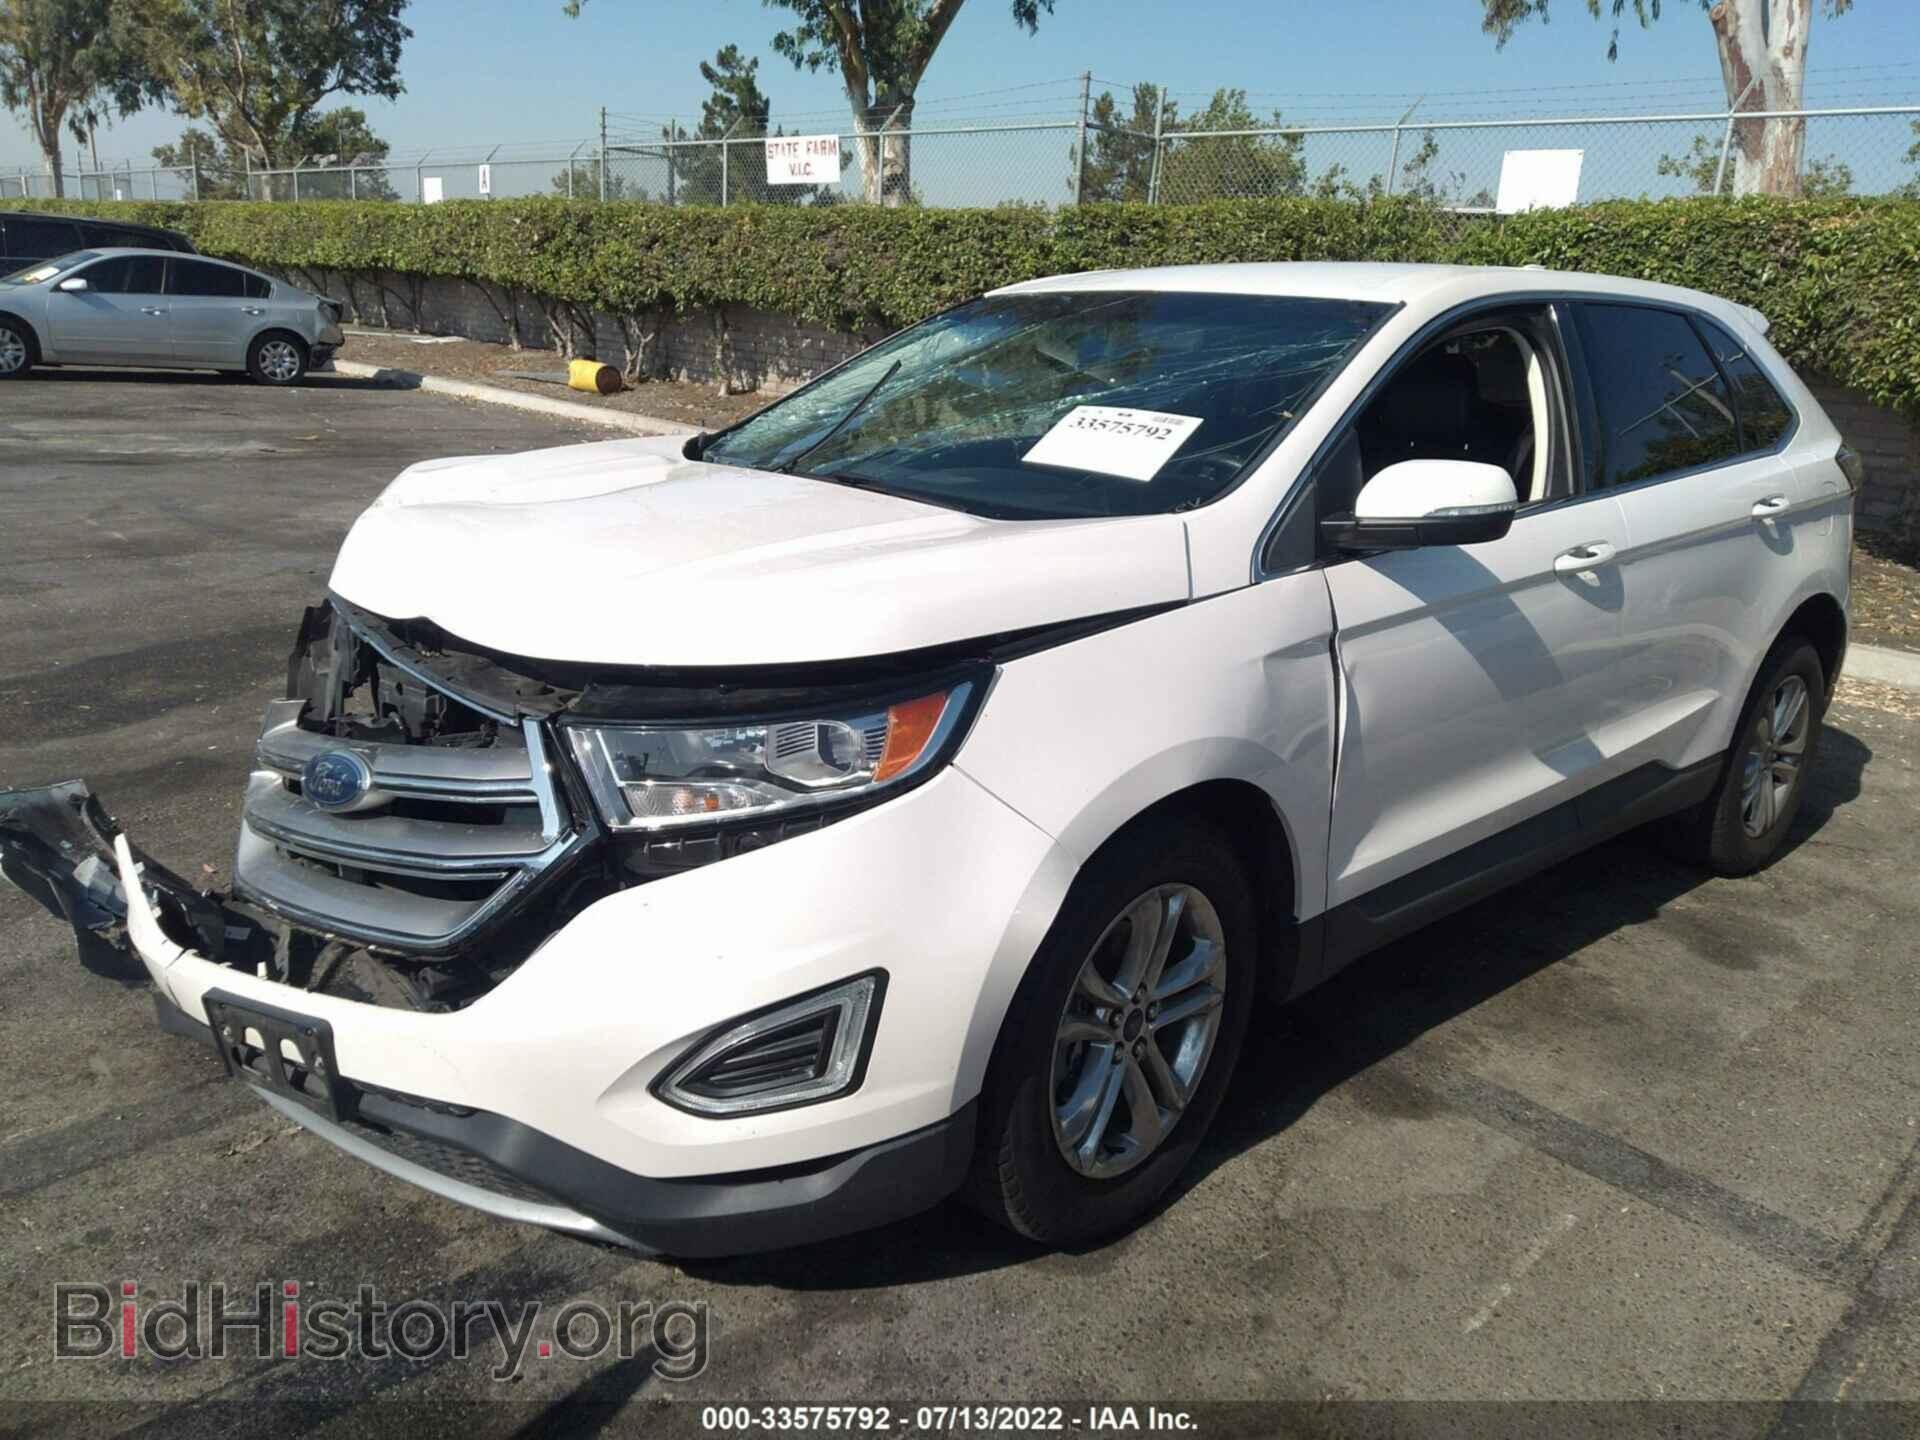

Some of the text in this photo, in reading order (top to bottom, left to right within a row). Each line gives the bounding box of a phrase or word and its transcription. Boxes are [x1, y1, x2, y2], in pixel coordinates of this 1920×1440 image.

[768, 139, 837, 159] STATE FARM
[1069, 416, 1173, 440] 33575792
[311, 761, 349, 796] Ford
